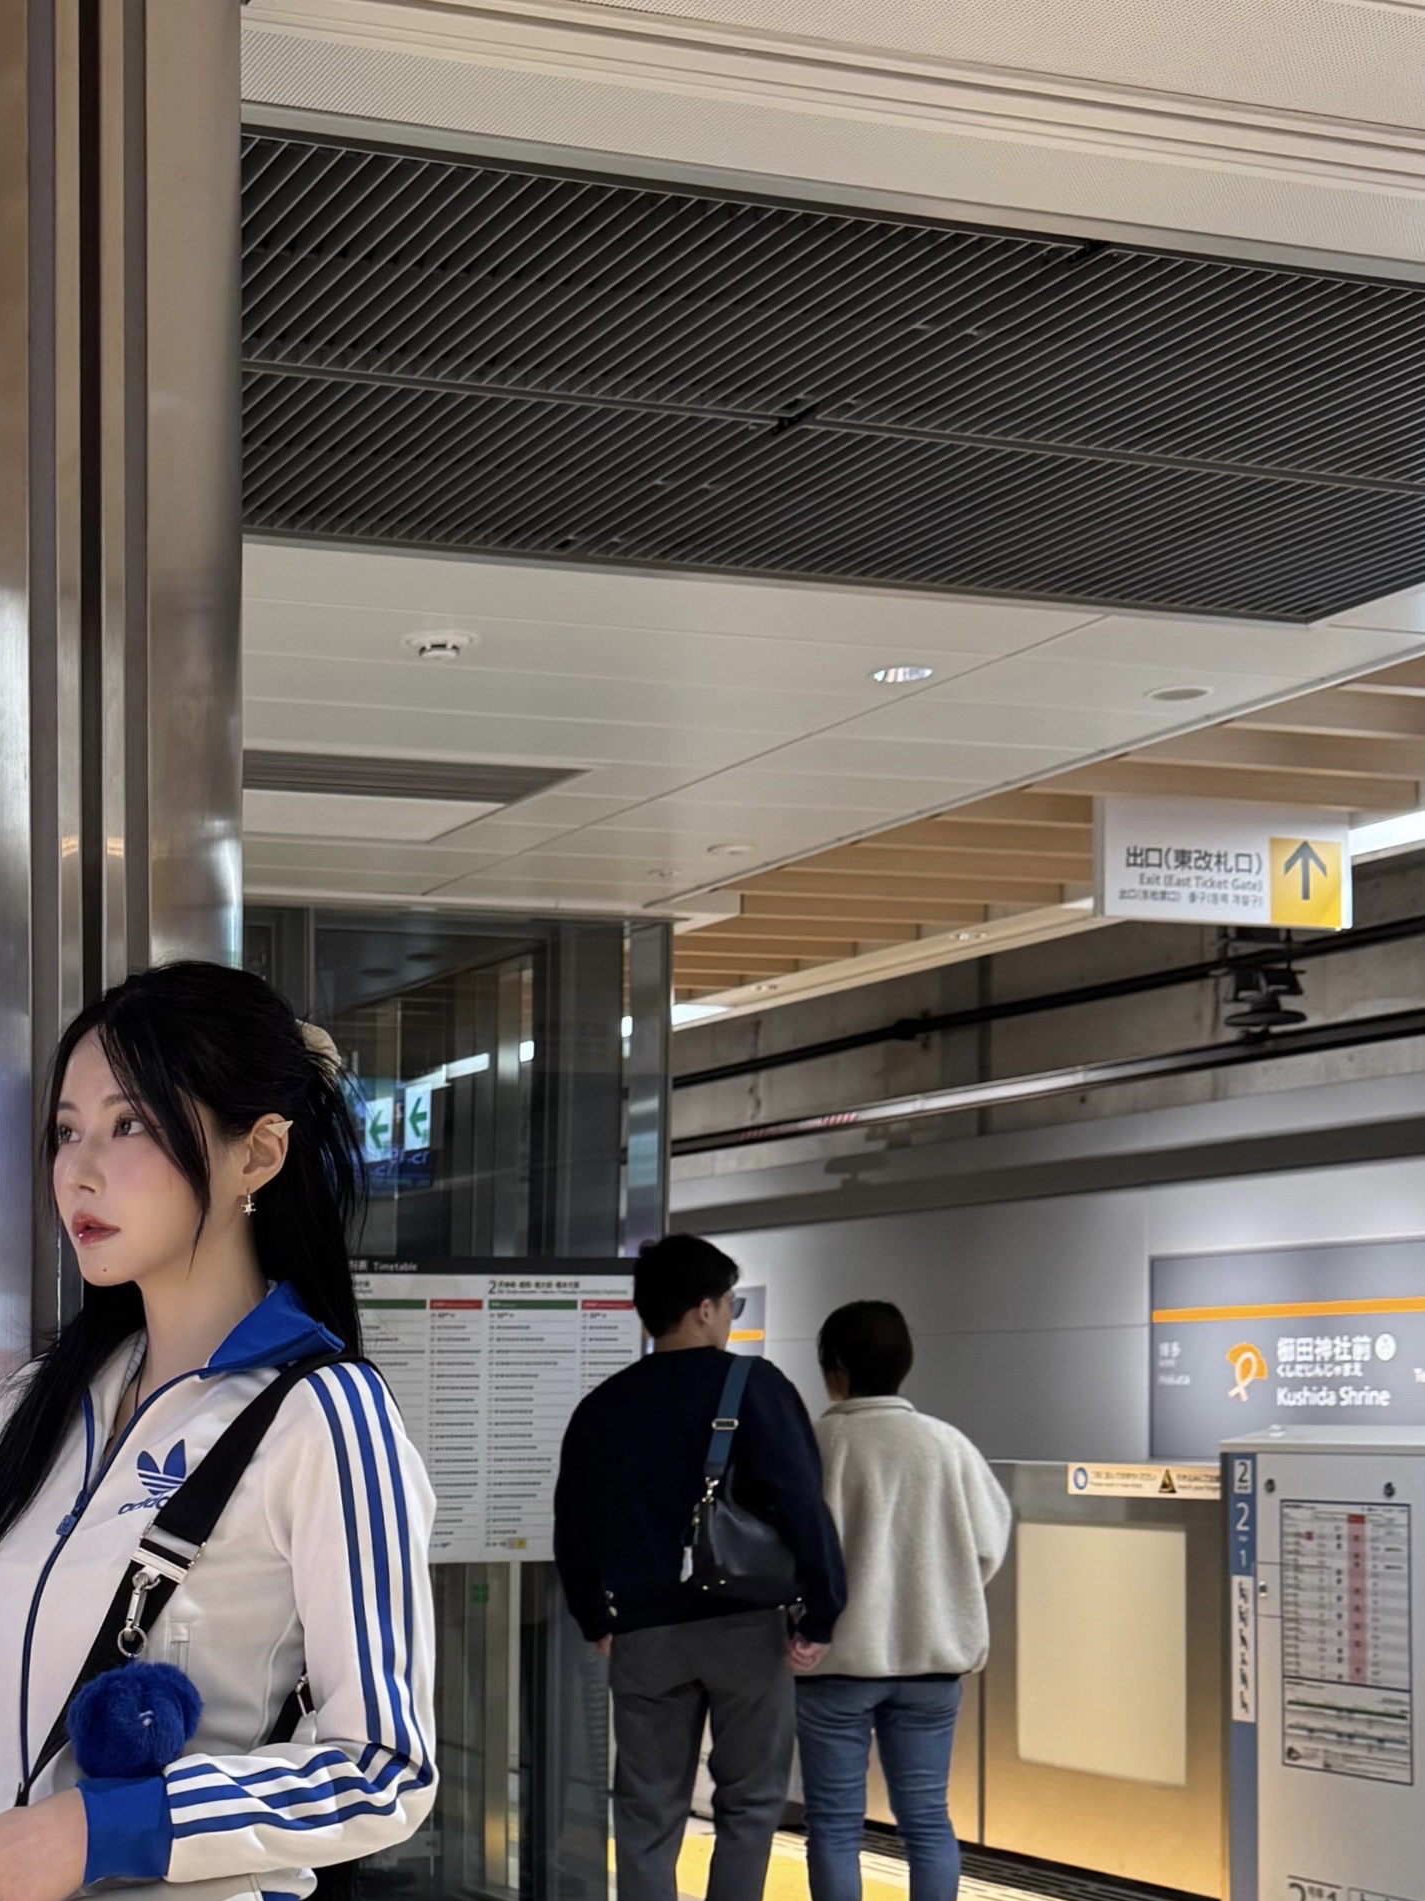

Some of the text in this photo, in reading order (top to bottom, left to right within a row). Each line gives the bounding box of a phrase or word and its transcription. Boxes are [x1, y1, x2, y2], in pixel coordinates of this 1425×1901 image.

[1139, 872, 1161, 886] Exit
[1194, 875, 1229, 890] Ticket
[1276, 1385, 1391, 1407] Kushida Shrine
[1237, 1461, 1249, 1484] 2
[1235, 1502, 1250, 1532] 2
